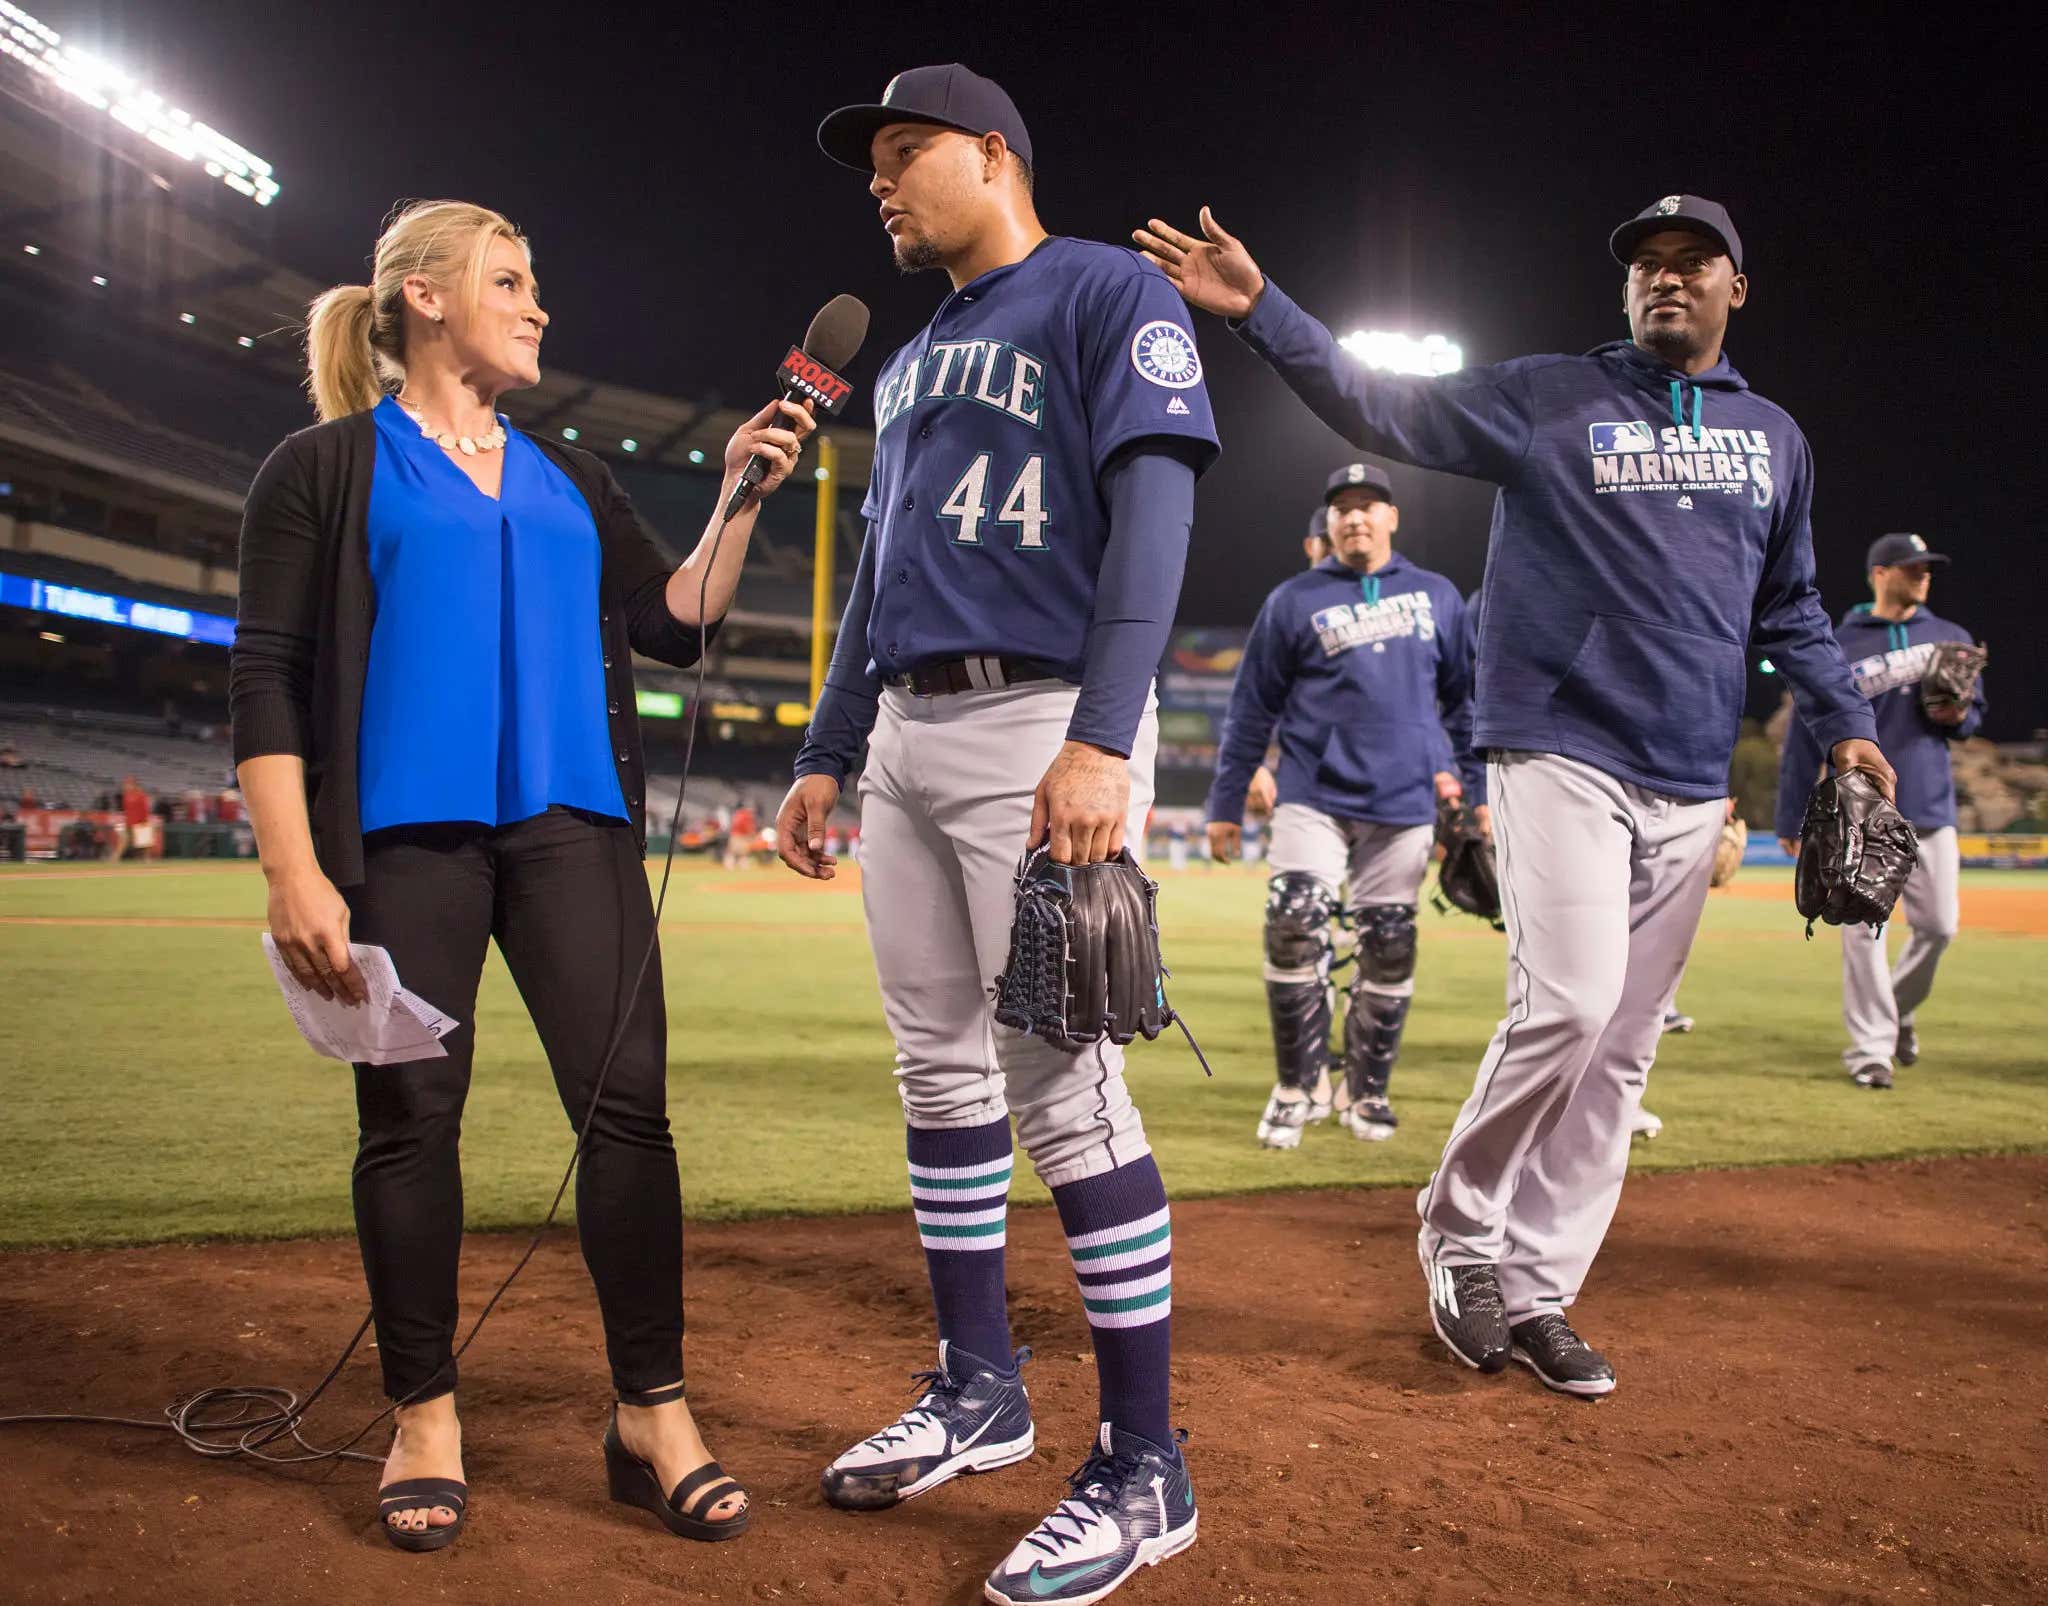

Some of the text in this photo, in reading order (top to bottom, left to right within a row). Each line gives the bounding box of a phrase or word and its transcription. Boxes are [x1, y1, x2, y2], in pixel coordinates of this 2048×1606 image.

[1141, 328, 1192, 352] SEATTLE
[784, 351, 850, 400] ROOT
[1142, 360, 1197, 382] MARINERS
[790, 375, 834, 408] SPORTS
[1660, 424, 1771, 456] SEATTLE
[1593, 453, 1748, 484] MARINERS
[939, 452, 1051, 551] 44
[1595, 482, 1744, 494] MLB AUTHENTIC COLLECTION
